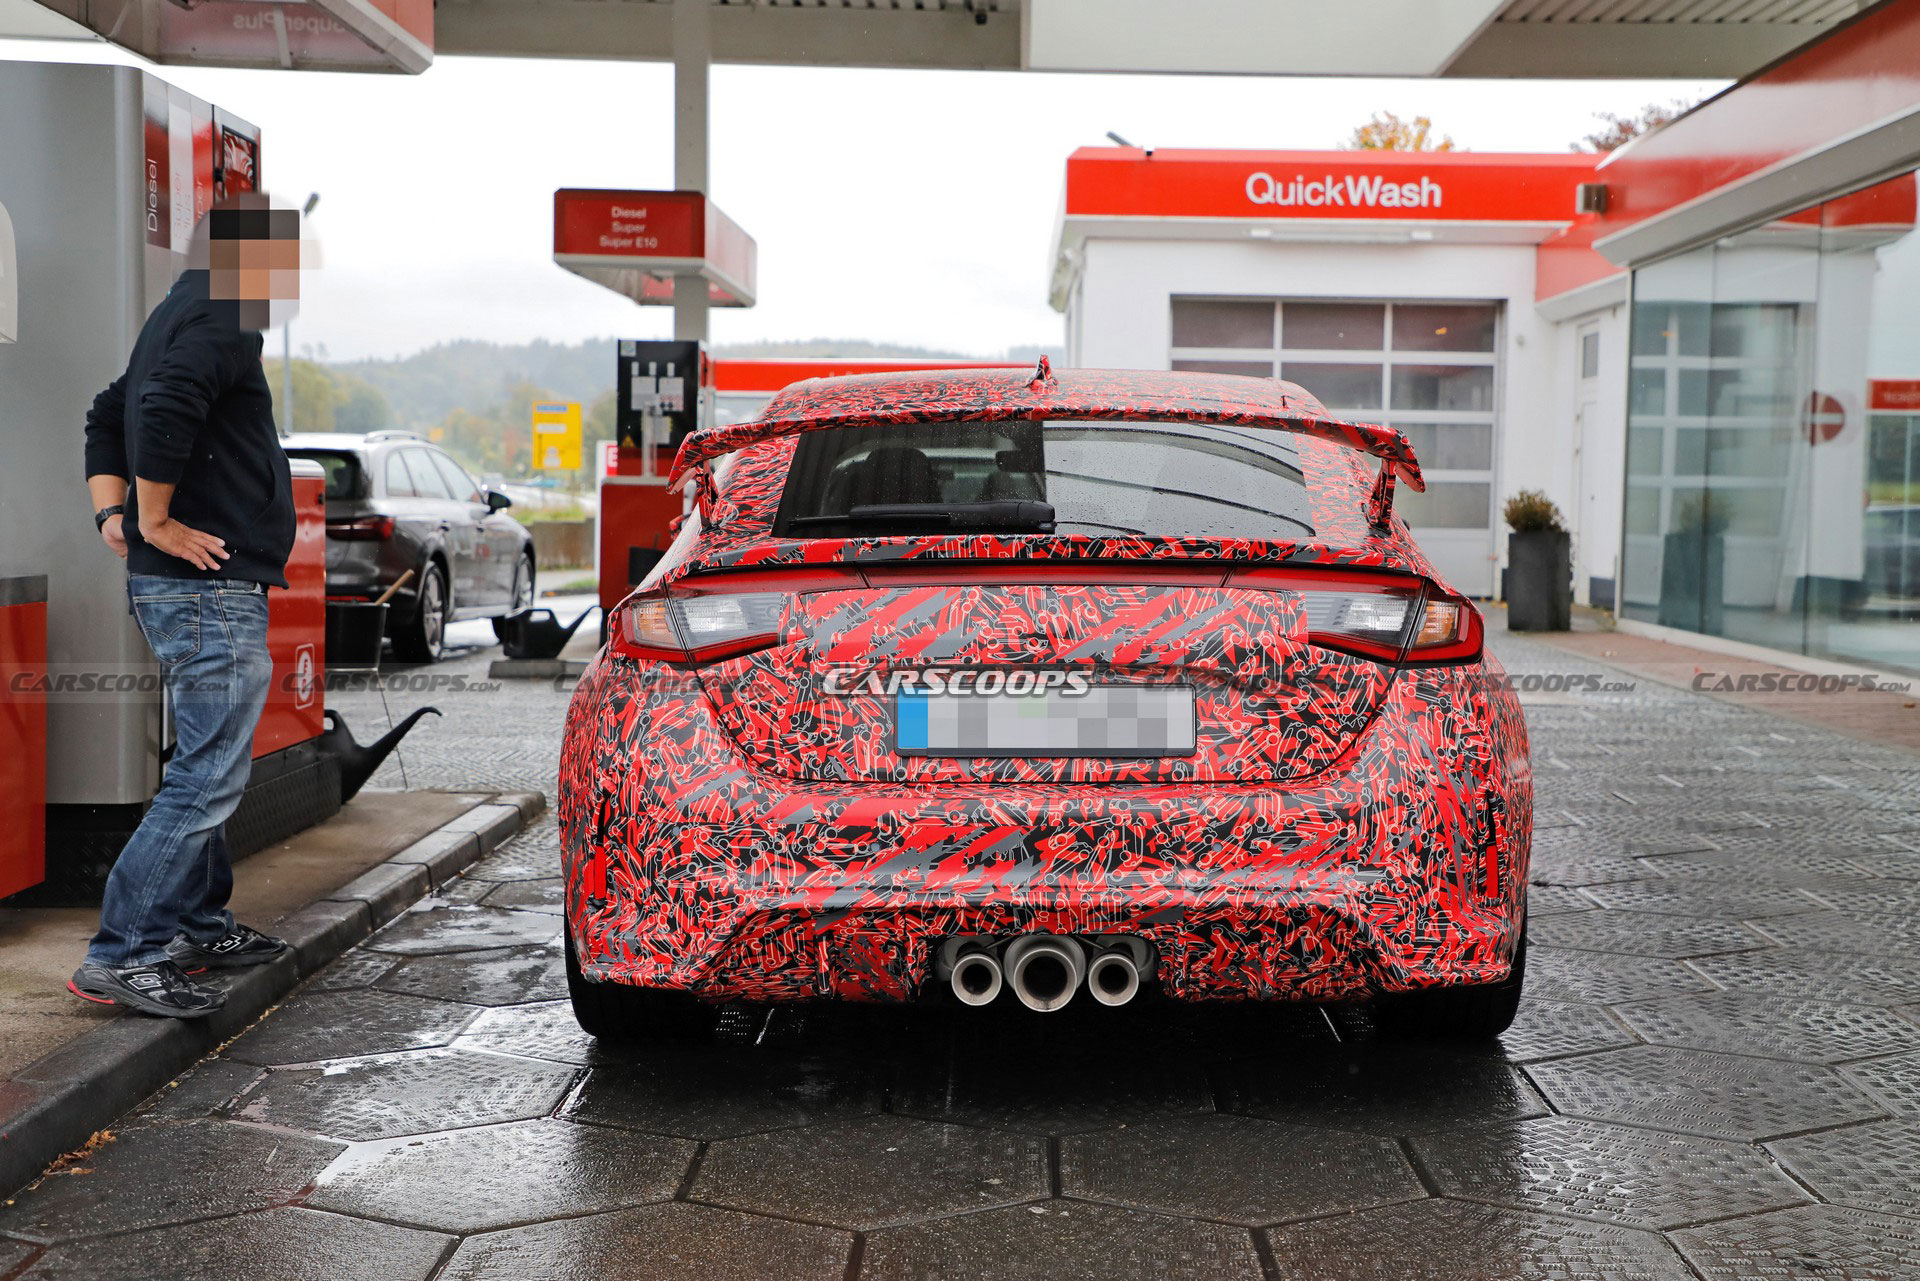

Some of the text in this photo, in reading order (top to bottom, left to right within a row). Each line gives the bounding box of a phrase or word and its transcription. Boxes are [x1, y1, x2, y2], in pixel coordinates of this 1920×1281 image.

[147, 158, 158, 232] Diesel
[1245, 171, 1442, 208] QuickWash
[611, 206, 647, 219] Diesel
[612, 221, 646, 234] Super
[599, 235, 658, 250] Super E10
